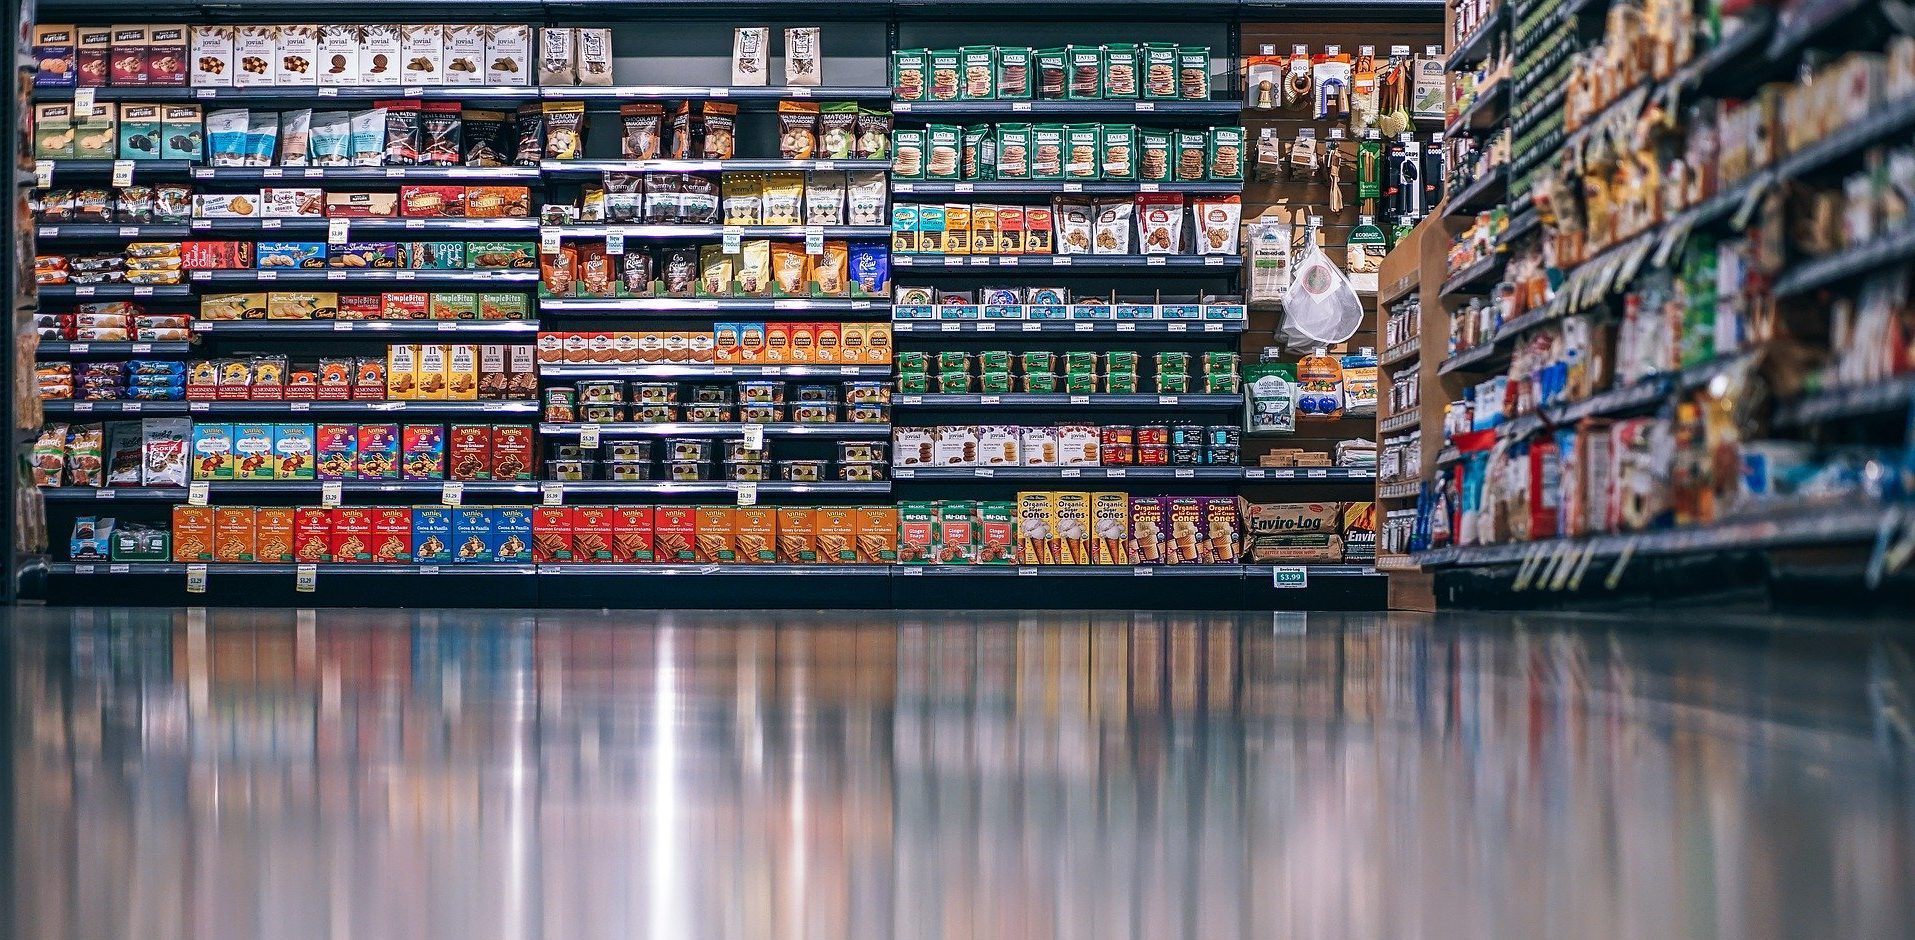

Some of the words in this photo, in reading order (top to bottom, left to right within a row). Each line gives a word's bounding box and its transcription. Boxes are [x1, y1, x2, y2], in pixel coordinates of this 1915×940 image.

[371, 38, 389, 46] jovial
[588, 260, 604, 271] Raw
[626, 258, 642, 269] Raw
[669, 262, 686, 271] Raw
[784, 259, 800, 269] Raw
[859, 260, 876, 270] Raw
[745, 510, 766, 518] Annie's
[826, 510, 847, 518] Annie's
[1134, 514, 1160, 522] Cones
[1172, 514, 1199, 522] Cones
[1251, 517, 1321, 530] Enviro-Log
[1349, 532, 1376, 542] Envir
